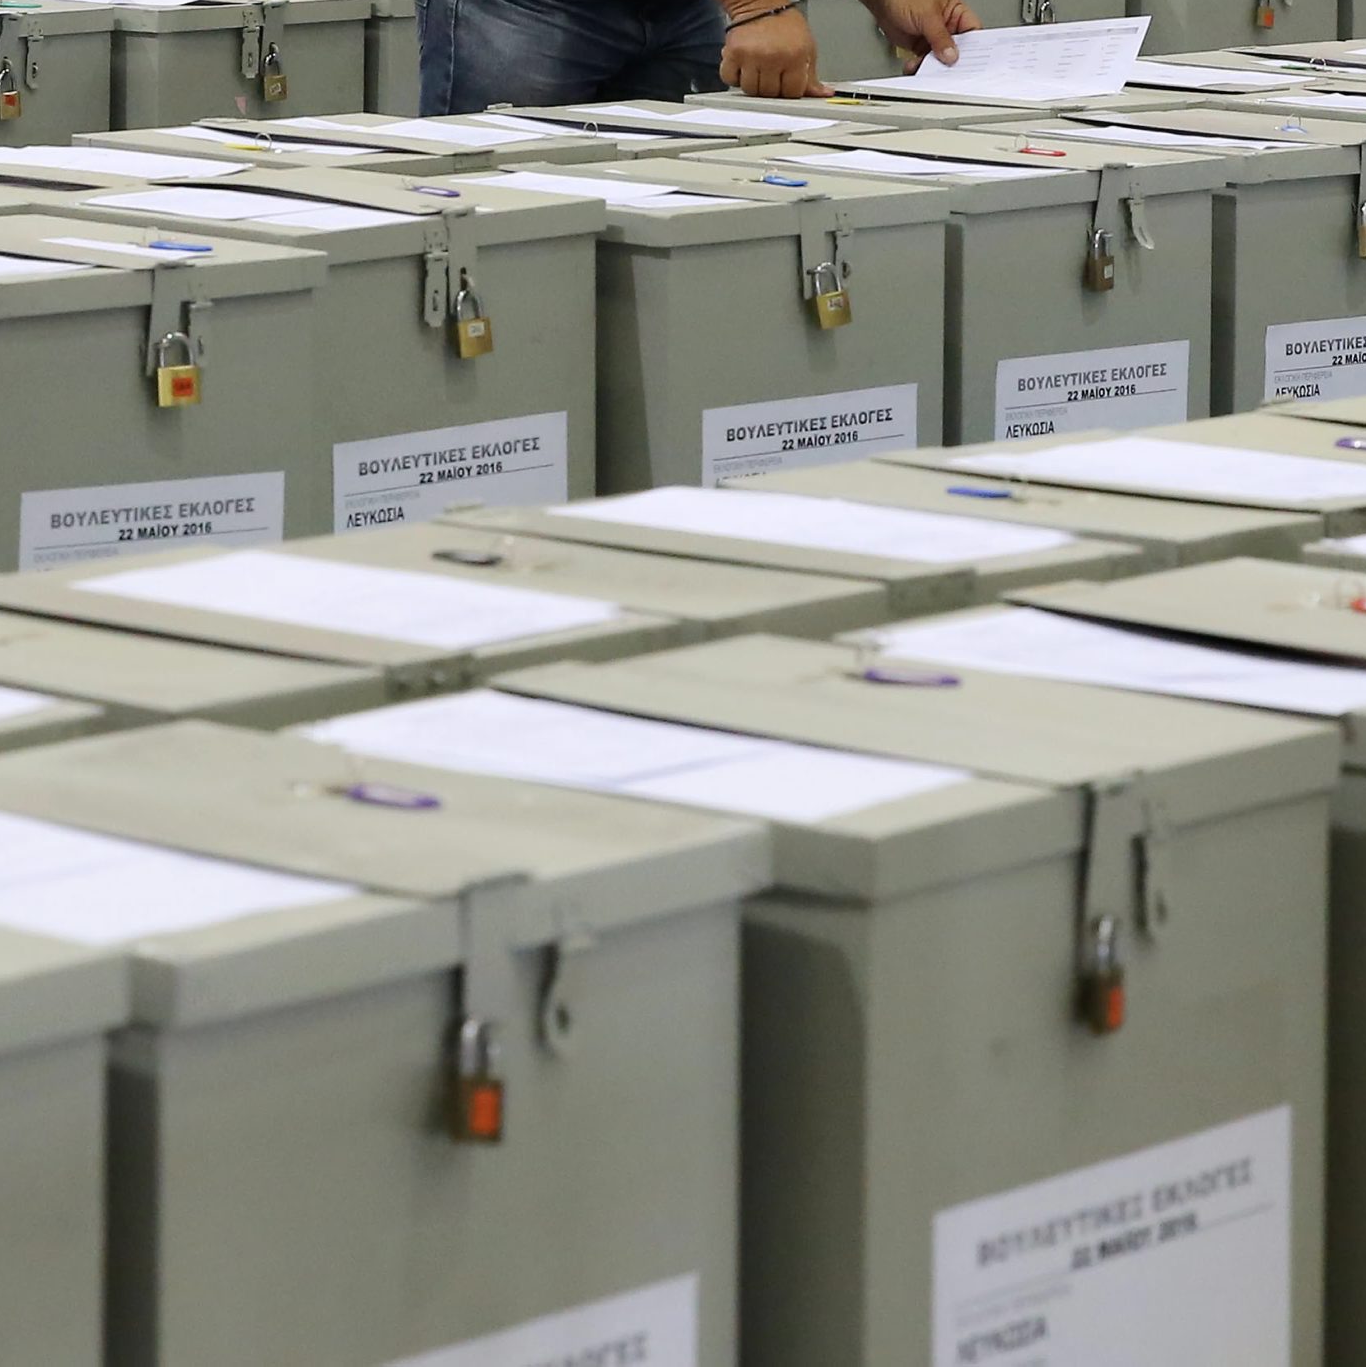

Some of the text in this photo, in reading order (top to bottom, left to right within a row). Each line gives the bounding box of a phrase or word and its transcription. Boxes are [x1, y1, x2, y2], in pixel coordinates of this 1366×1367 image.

[1332, 356, 1342, 365] 22
[1018, 363, 1167, 391] ΒΟΥΛΕΥΤΙΚΕΣ ΕΚΛΟΓΕΣ
[1067, 391, 1078, 401] 22
[1115, 384, 1135, 396] 2016
[727, 408, 893, 442] ΒΟΥΛΕΥΤΙΚΕΣ ΕΚΛΟΓΕΣ
[1006, 421, 1054, 438] ΛΕΥΚΩΣΙΑ
[782, 439, 794, 450] 22
[835, 430, 858, 444] 2016
[358, 437, 541, 476] ΒΟΥΛΕΥΤΙΚΕΣ ΕΚΛΟΓΕΣ
[419, 473, 433, 484] 22
[476, 462, 503, 475] 2016
[50, 497, 256, 529] ΒΟΥΛΕΥΤΙΚΕΣ ΕΚΛΟΓΕΣ
[346, 506, 405, 528] ΛΕΥΚΩΣΙΑ
[118, 529, 134, 541] 22
[184, 522, 212, 535] 2016
